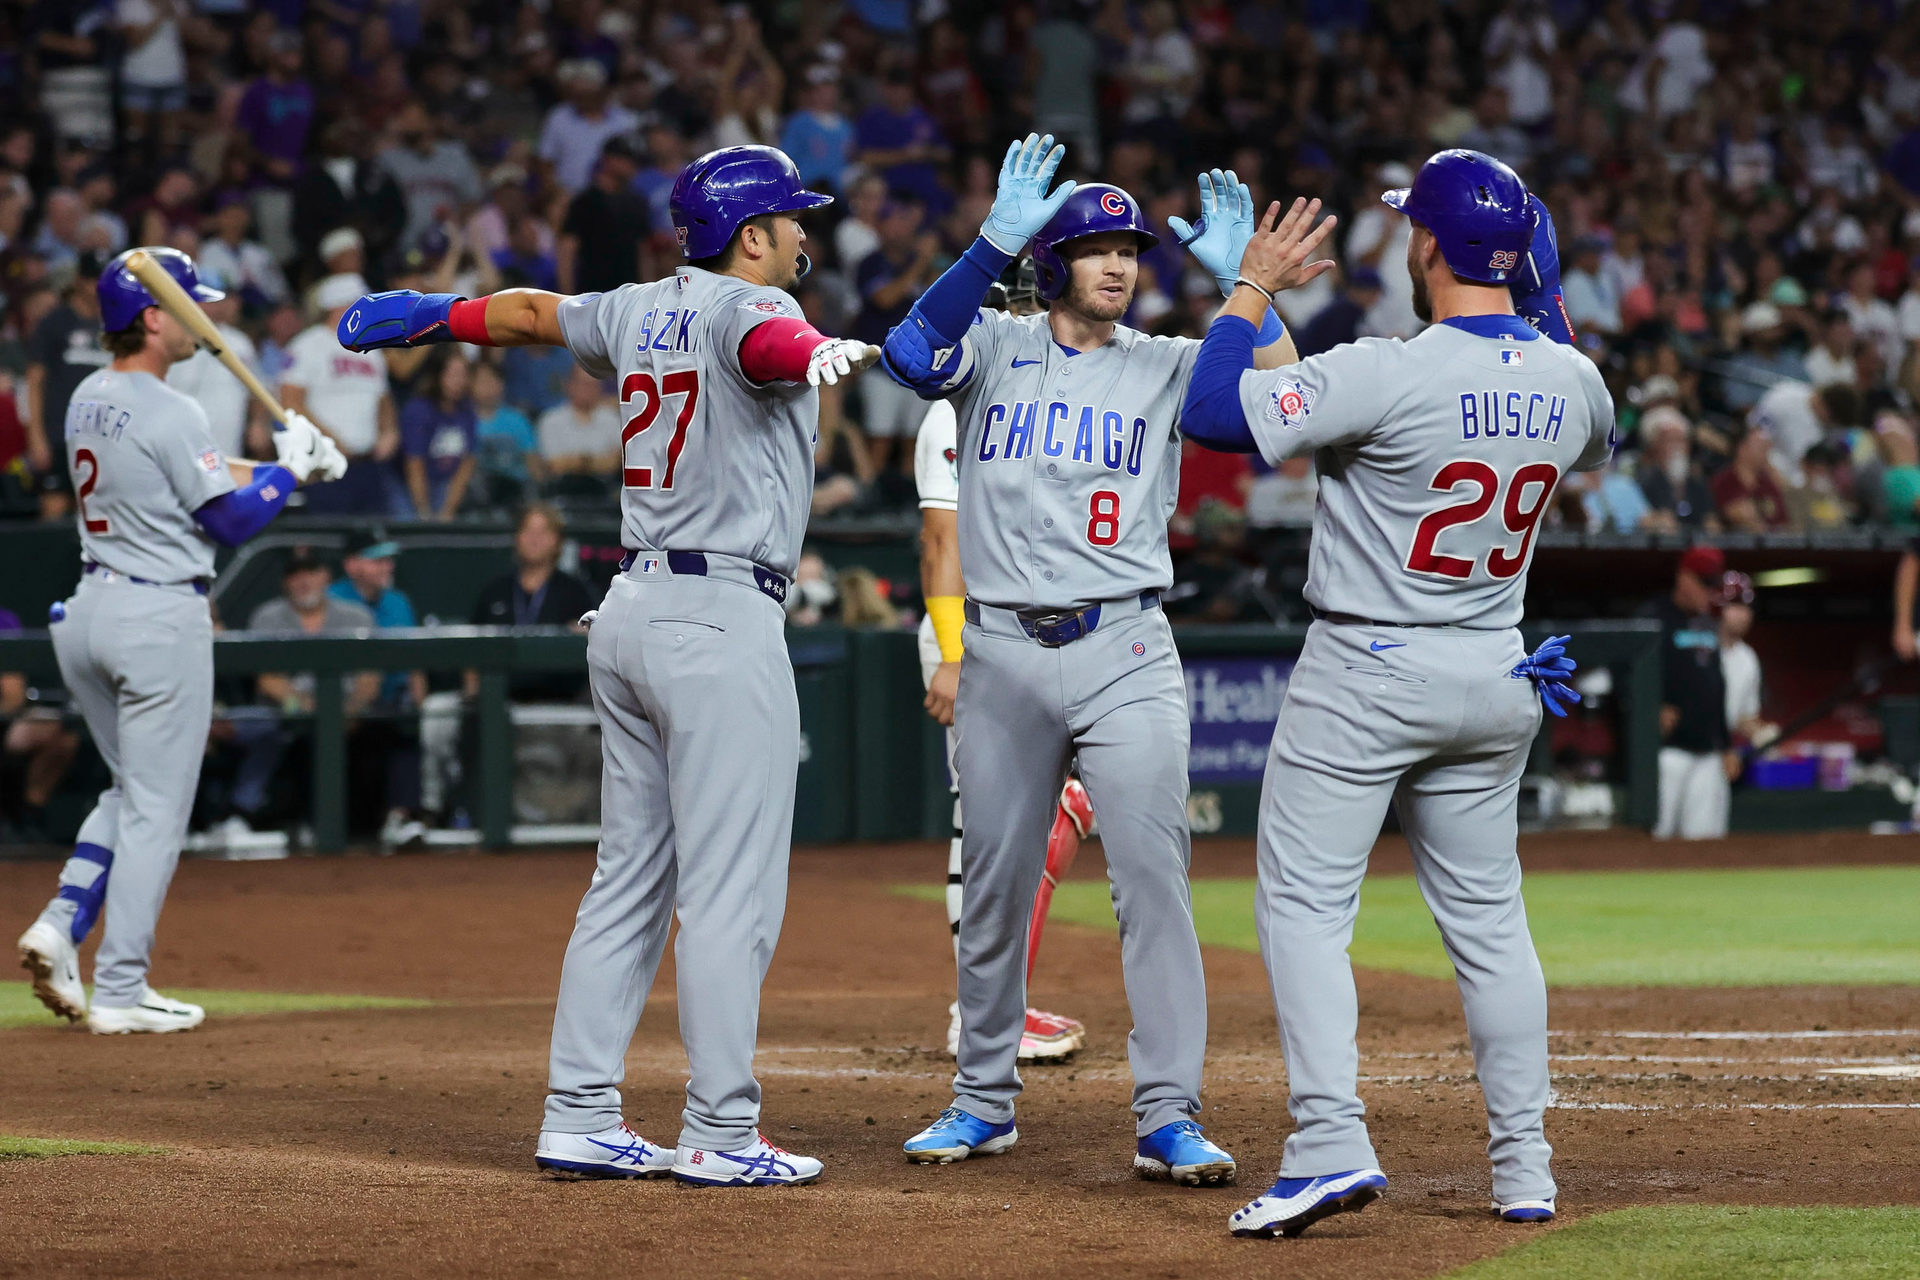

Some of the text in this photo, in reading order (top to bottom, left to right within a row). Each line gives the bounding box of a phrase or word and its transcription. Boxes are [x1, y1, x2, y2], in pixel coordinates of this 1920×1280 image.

[1101, 192, 1125, 216] C
[1489, 250, 1517, 269] 29
[619, 368, 700, 492] 27
[1458, 389, 1567, 445] BUSCH
[75, 448, 109, 534] 2
[1086, 488, 1120, 547] 8
[1403, 458, 1560, 581] 29
